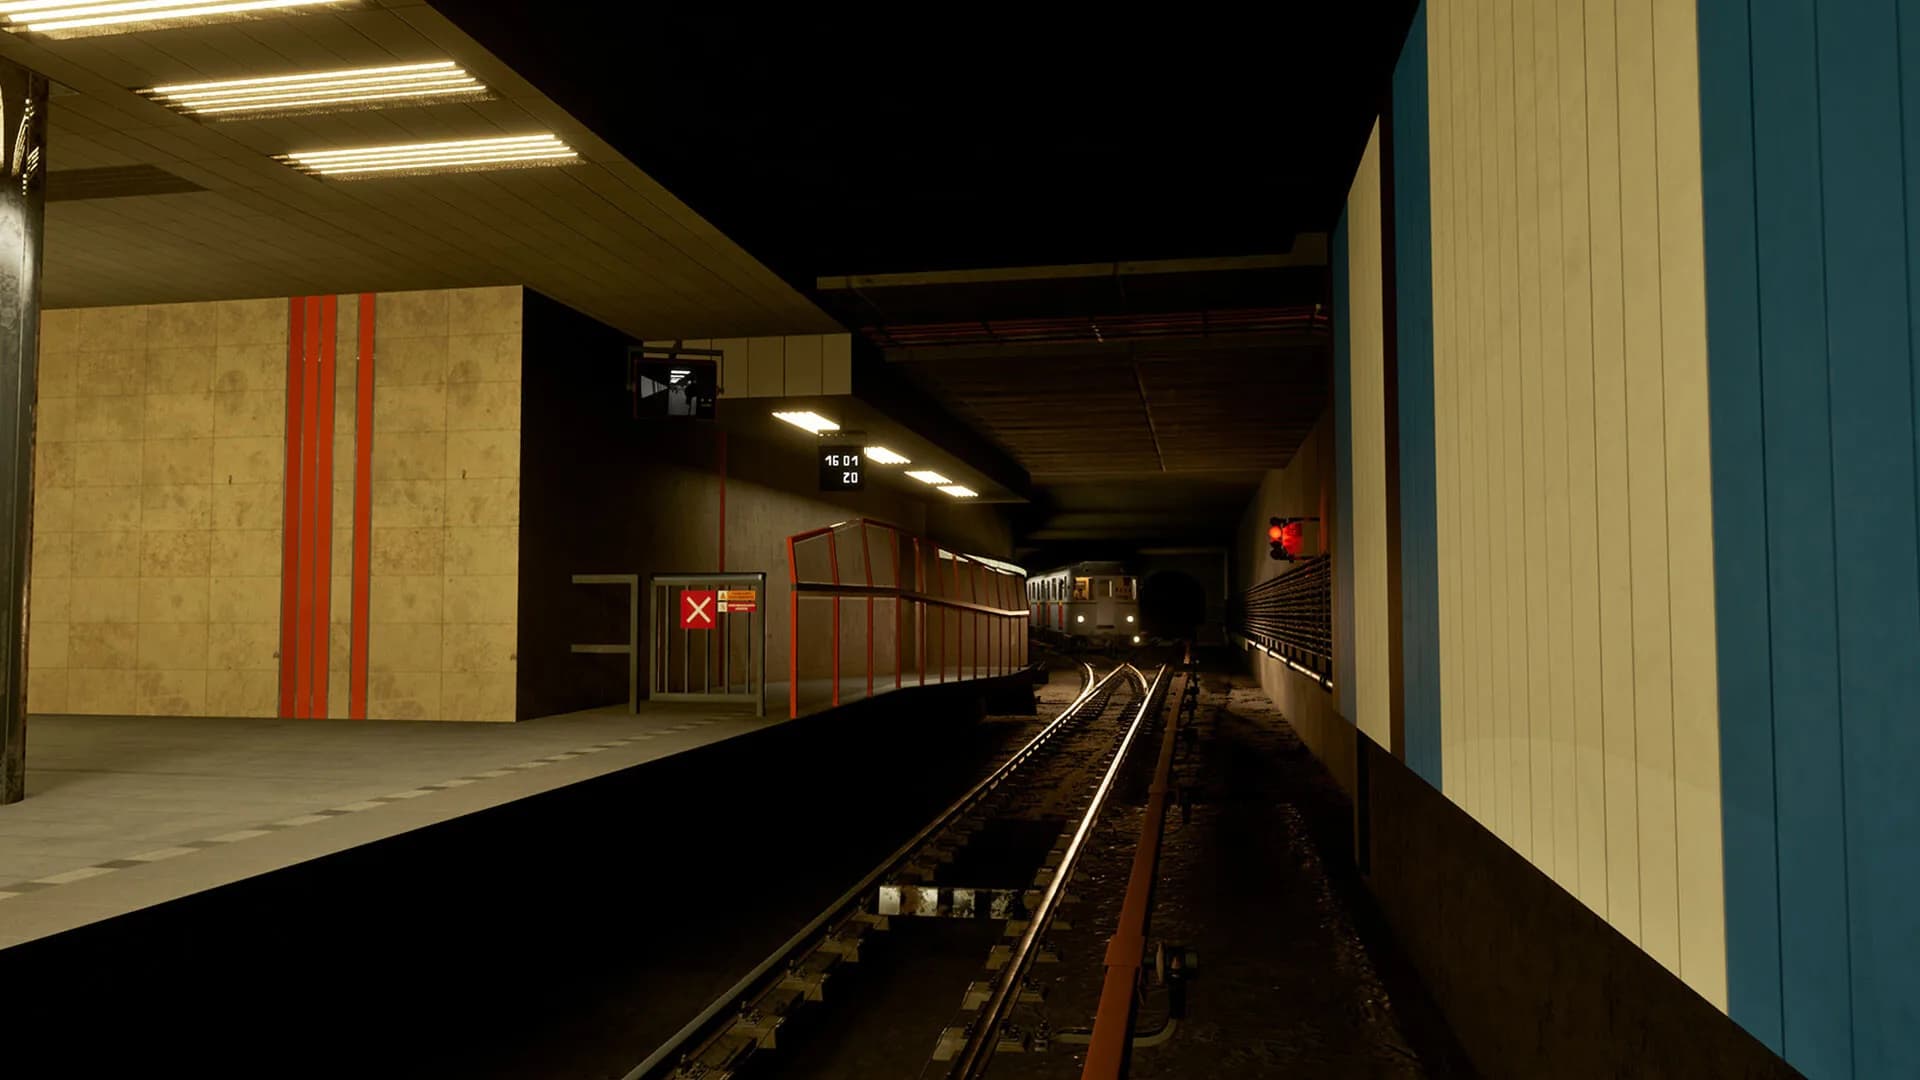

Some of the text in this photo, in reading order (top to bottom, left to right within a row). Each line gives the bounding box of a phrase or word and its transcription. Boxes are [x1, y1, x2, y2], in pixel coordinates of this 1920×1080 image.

[825, 455, 858, 466] 16 01
[843, 472, 858, 483] 20
